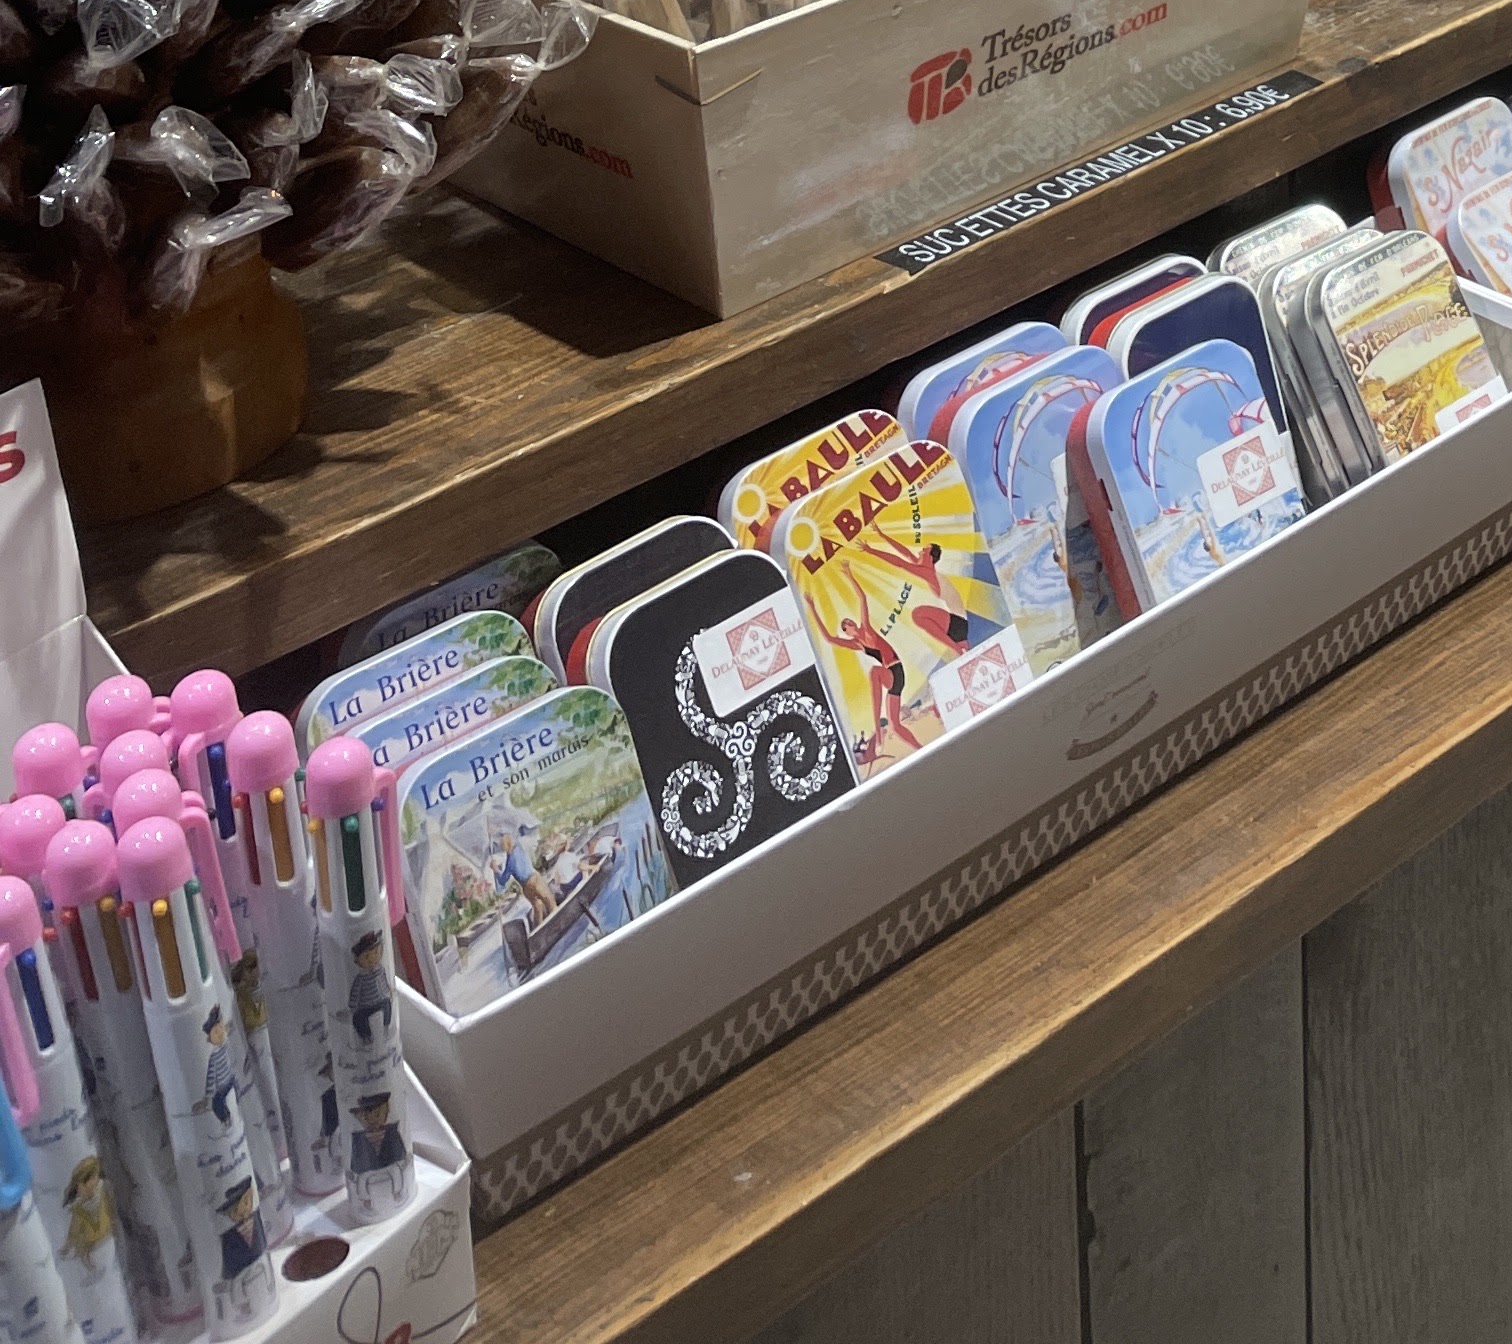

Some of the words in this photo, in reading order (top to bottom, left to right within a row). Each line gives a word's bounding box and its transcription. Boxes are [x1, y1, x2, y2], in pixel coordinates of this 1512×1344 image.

[981, 13, 1072, 64] Trésors
[1036, 131, 1166, 201] CARAMEL
[1170, 113, 1213, 143] 10
[781, 410, 896, 503] BAULE
[803, 540, 844, 575] LA
[833, 442, 949, 543] BAULE
[888, 581, 913, 625] PLAGE
[329, 696, 363, 727] La
[376, 648, 461, 703] Brière
[373, 746, 390, 770] a
[404, 695, 489, 752] Brière
[420, 775, 455, 811] La
[469, 725, 555, 782] Brière
[477, 784, 493, 804] et
[501, 766, 530, 792] son
[537, 732, 590, 772] marais
